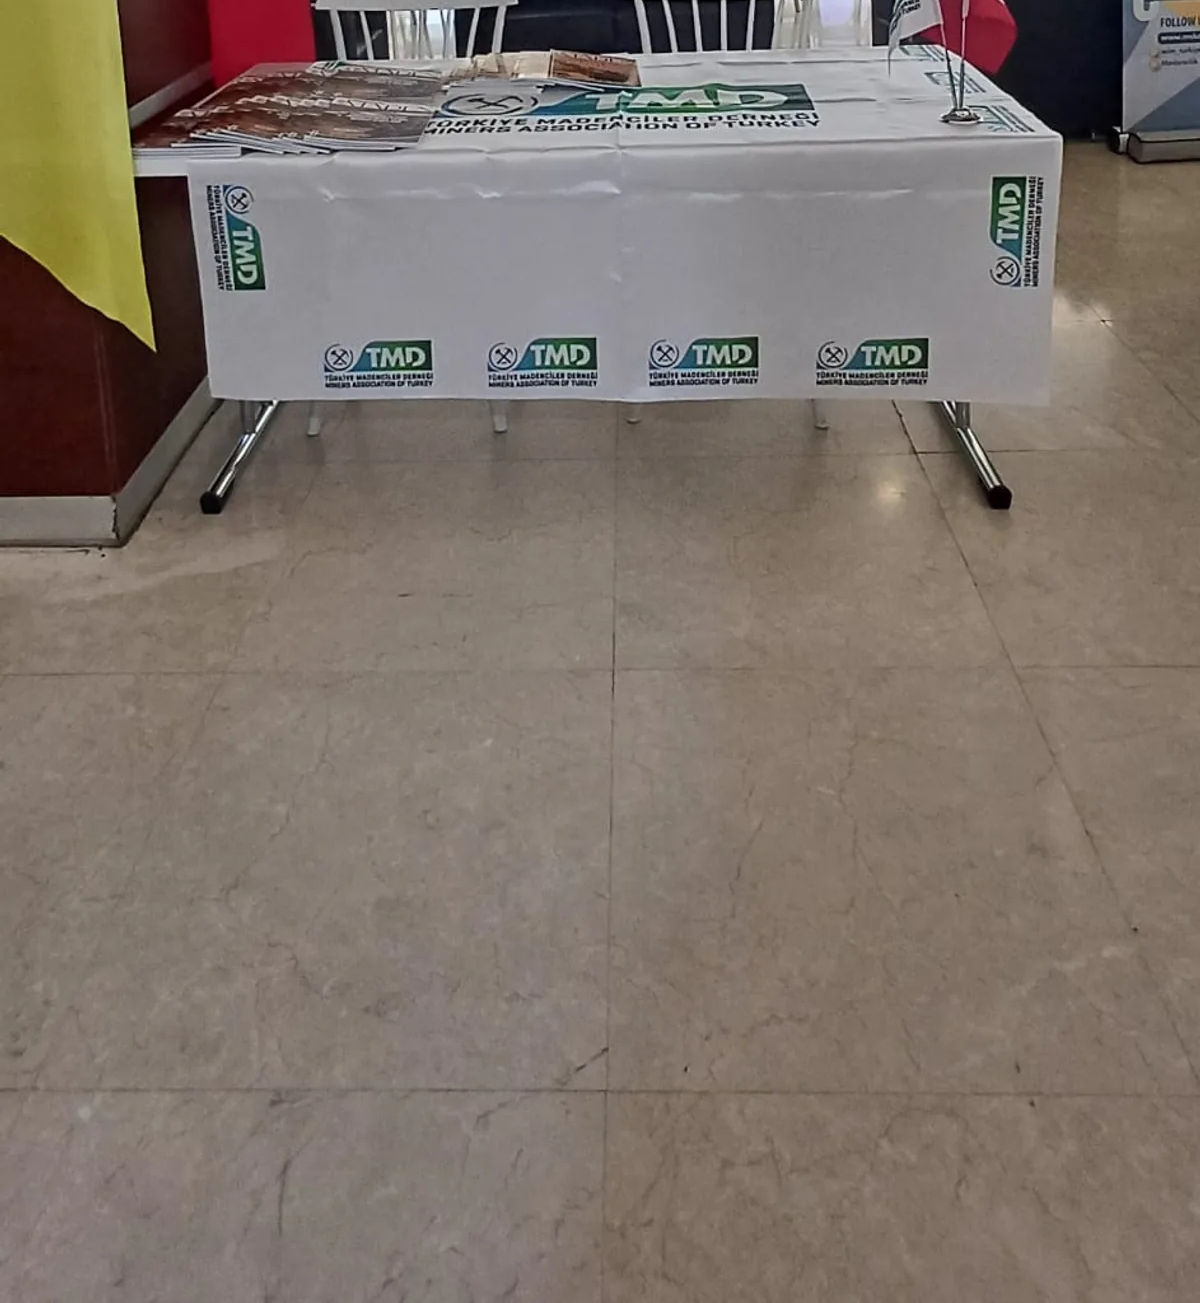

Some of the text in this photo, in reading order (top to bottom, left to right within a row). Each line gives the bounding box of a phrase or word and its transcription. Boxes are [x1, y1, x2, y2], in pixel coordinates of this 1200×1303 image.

[1160, 16, 1196, 27] FOLLOW
[585, 89, 788, 111] TMD
[424, 119, 821, 135] MINERS ASSOCIATION OF TURKEY
[996, 183, 1022, 244] TMD
[232, 226, 258, 285] TMD
[365, 347, 426, 368] TMD
[529, 344, 591, 366] TMD
[692, 344, 753, 365] TMD
[860, 344, 923, 366] TMD
